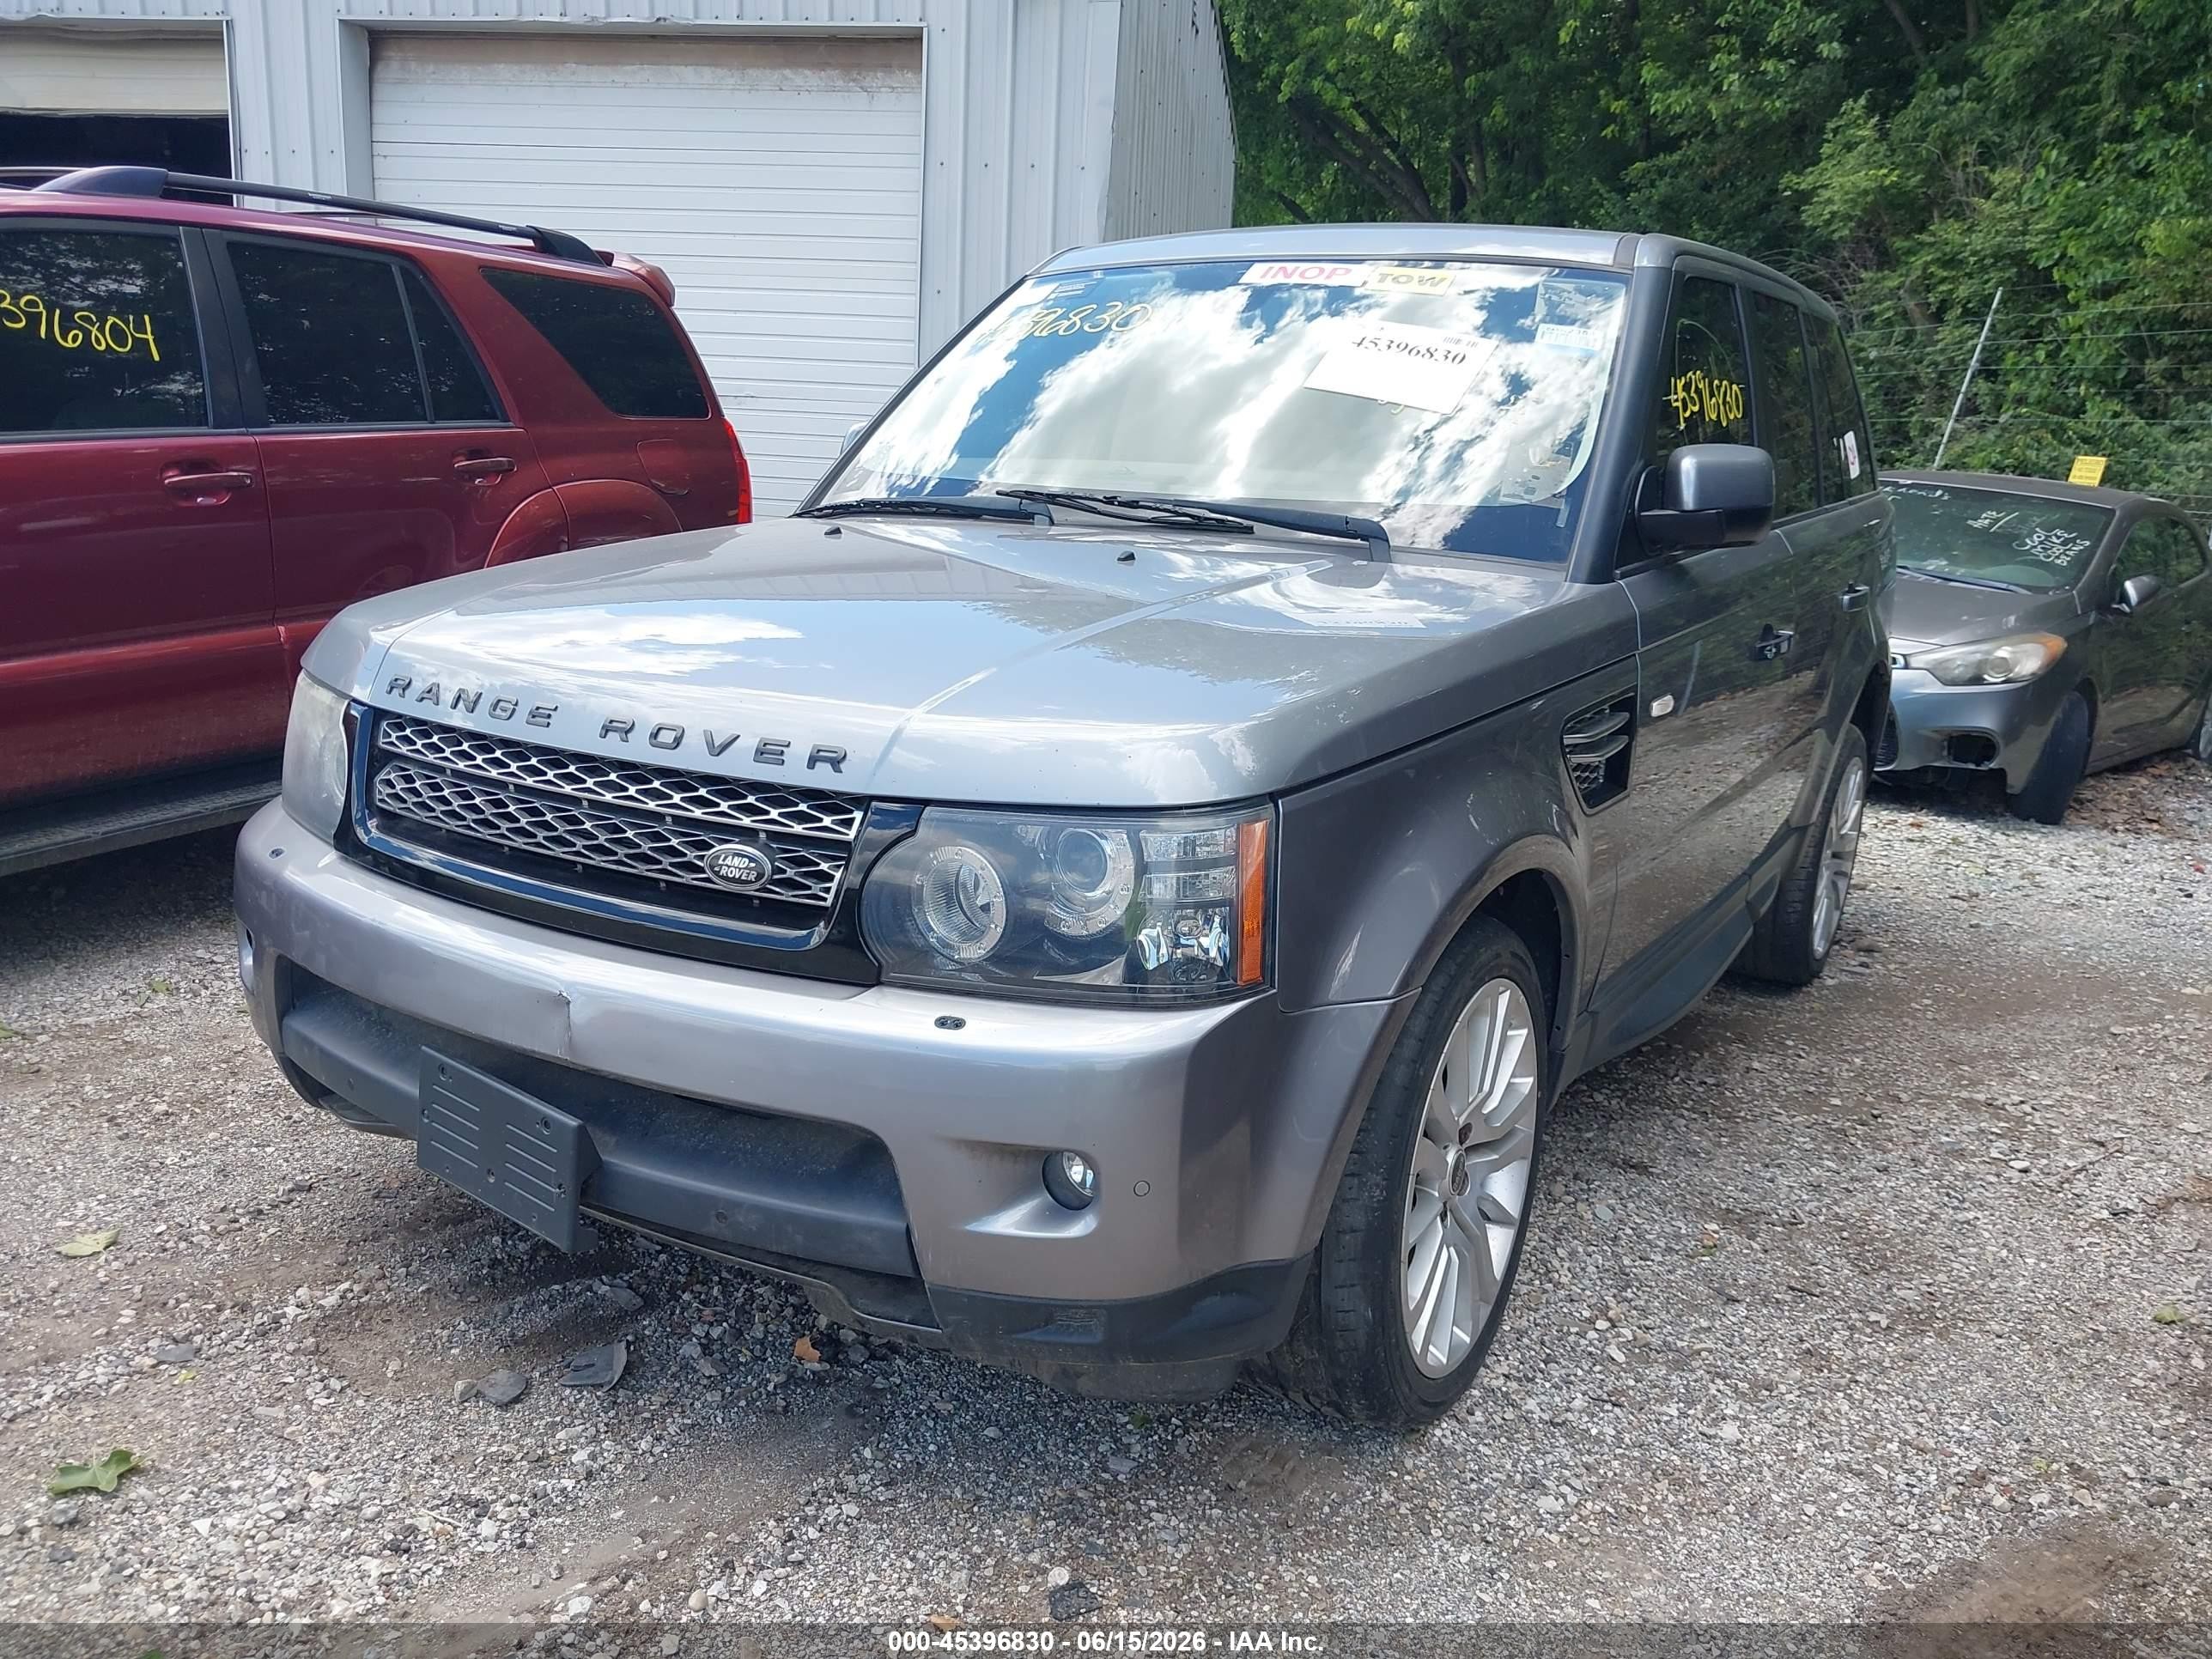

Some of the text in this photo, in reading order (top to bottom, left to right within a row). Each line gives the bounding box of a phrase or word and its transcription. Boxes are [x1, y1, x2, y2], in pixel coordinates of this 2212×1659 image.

[1260, 265, 1353, 281] INOP
[1376, 272, 1449, 289] TOW
[0, 289, 161, 362] 396804
[1352, 335, 1467, 365] 45396830
[385, 675, 848, 773] RANGE ROVER
[718, 854, 750, 868] LAND
[719, 866, 757, 882] ROVER
